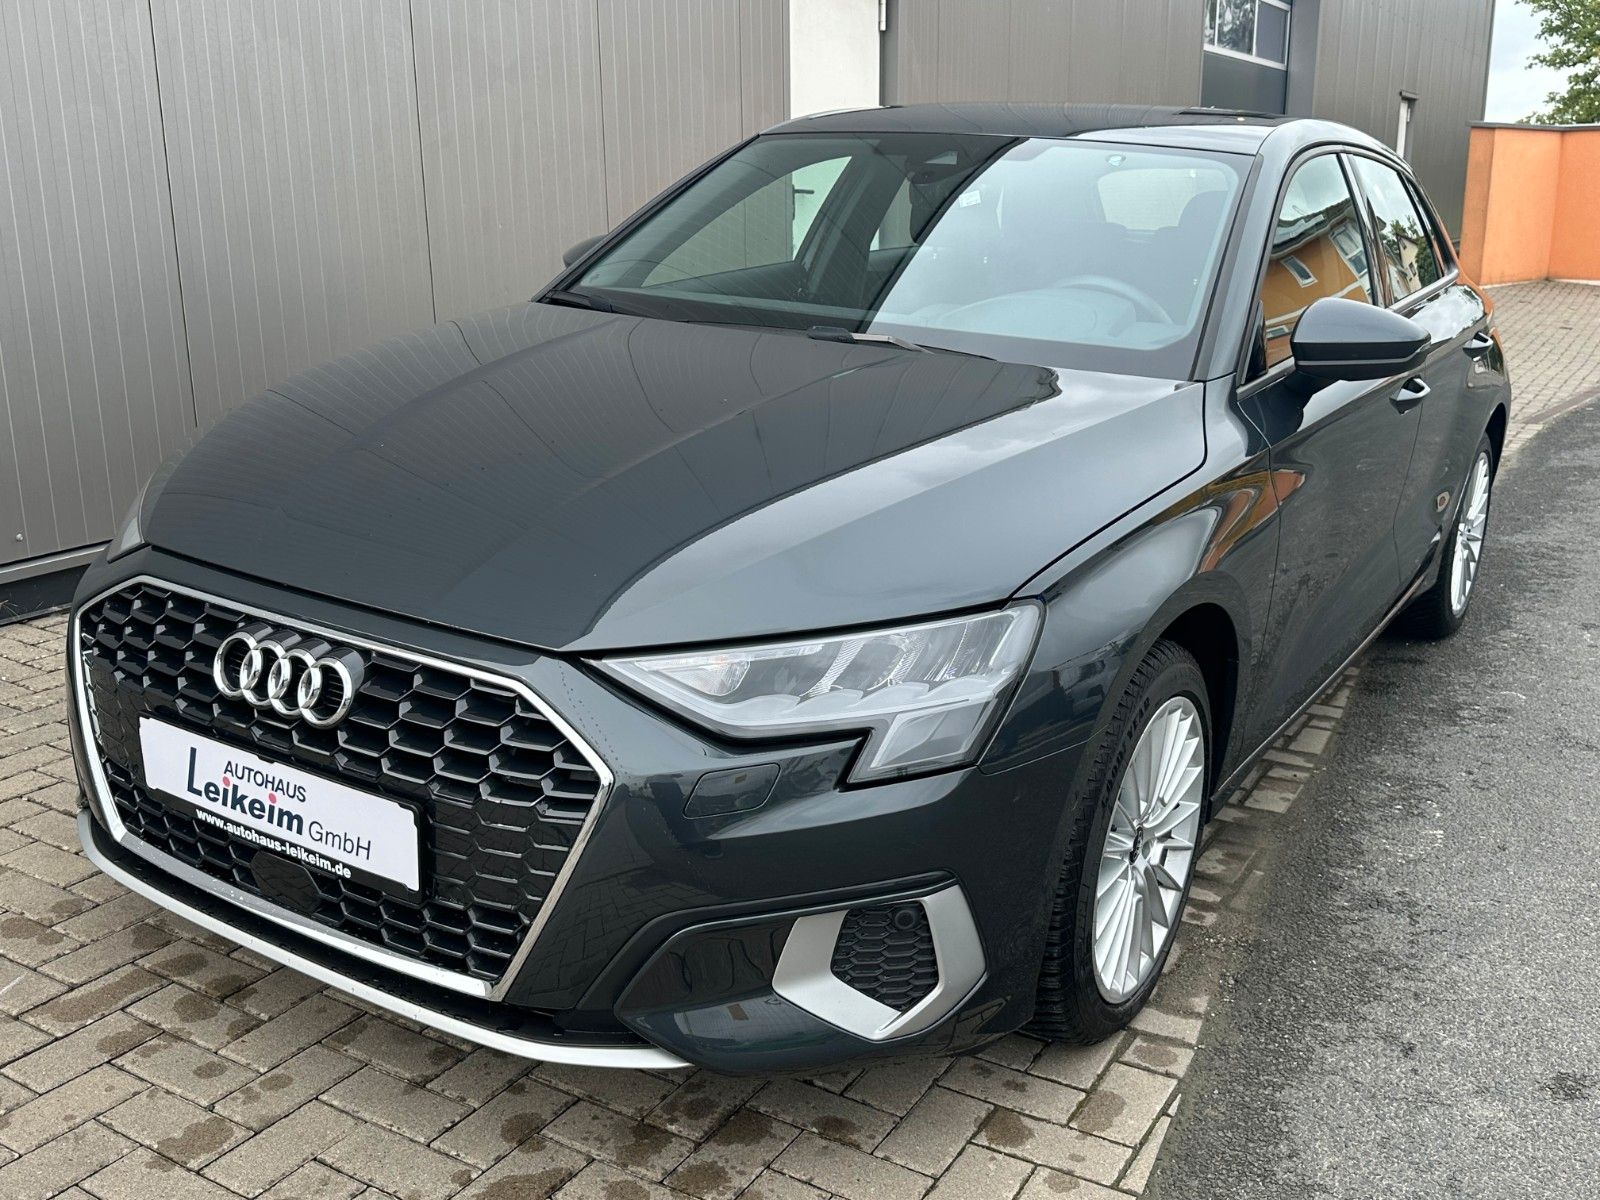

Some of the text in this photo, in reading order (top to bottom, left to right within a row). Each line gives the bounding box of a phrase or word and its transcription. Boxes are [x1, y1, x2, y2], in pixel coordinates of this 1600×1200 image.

[187, 746, 371, 860] Leikeim GmbH
[223, 760, 306, 802] AUTOHAUS
[196, 808, 351, 879] www.autohaus-leikeim.de
